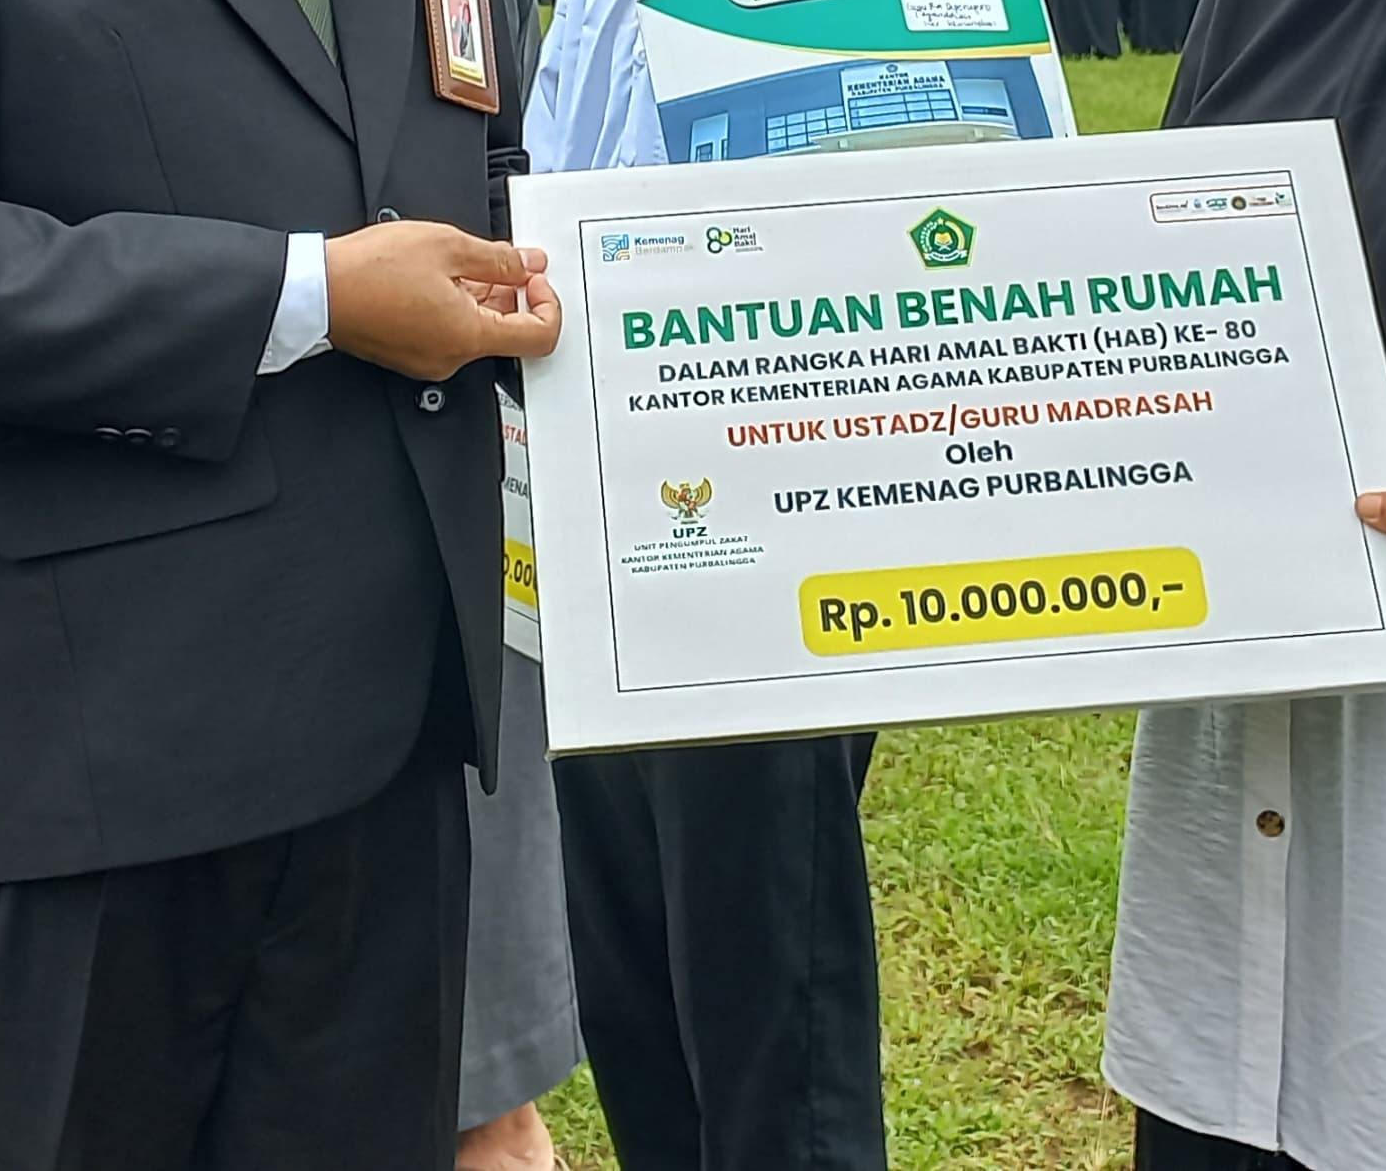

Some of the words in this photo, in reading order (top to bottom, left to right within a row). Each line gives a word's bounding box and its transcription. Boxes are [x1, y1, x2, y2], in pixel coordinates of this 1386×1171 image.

[847, 78, 910, 91] KEMENTERIAN
[914, 75, 945, 84] AGAMA
[634, 234, 685, 246] Kemenag
[622, 293, 883, 350] BANTUAN
[896, 279, 1076, 329] BENAH
[1087, 265, 1283, 314] RUMAH
[658, 358, 750, 383] DALAM
[755, 350, 866, 376] RANGKA
[870, 344, 931, 366] HARI
[937, 339, 1008, 361] AMAL
[1012, 332, 1087, 356] BAKTI
[1093, 322, 1168, 354] (HAB)
[1225, 319, 1257, 340] 80
[628, 390, 725, 412] KANTOR
[731, 375, 891, 405] KEMENTERIAN
[896, 370, 984, 392] AGAMA
[988, 358, 1124, 385] KABUPATEN
[1129, 346, 1290, 374] PURBALINGGA
[726, 418, 827, 447] UNTUK
[834, 403, 1040, 438] USTADZ/GURU
[1047, 391, 1213, 424] MADRASAH
[945, 440, 1014, 465] Oleh
[774, 490, 831, 514] UPZ
[837, 477, 980, 510] KEMENAG
[987, 461, 1194, 498] PURBALINGGA
[634, 543, 656, 551] UNIT
[659, 539, 717, 549] PENGUMPUL
[719, 535, 749, 545] ZAKAT
[672, 526, 708, 539] UPZ
[621, 555, 660, 564] KANTOR
[662, 549, 728, 561] KEMENTERIAN
[729, 546, 764, 556] AGAMA
[631, 563, 687, 574] KABUPATEN
[689, 557, 756, 569] PURBALINGGA
[819, 598, 892, 642] Rp.
[900, 572, 1184, 626] 10.000.000,-
